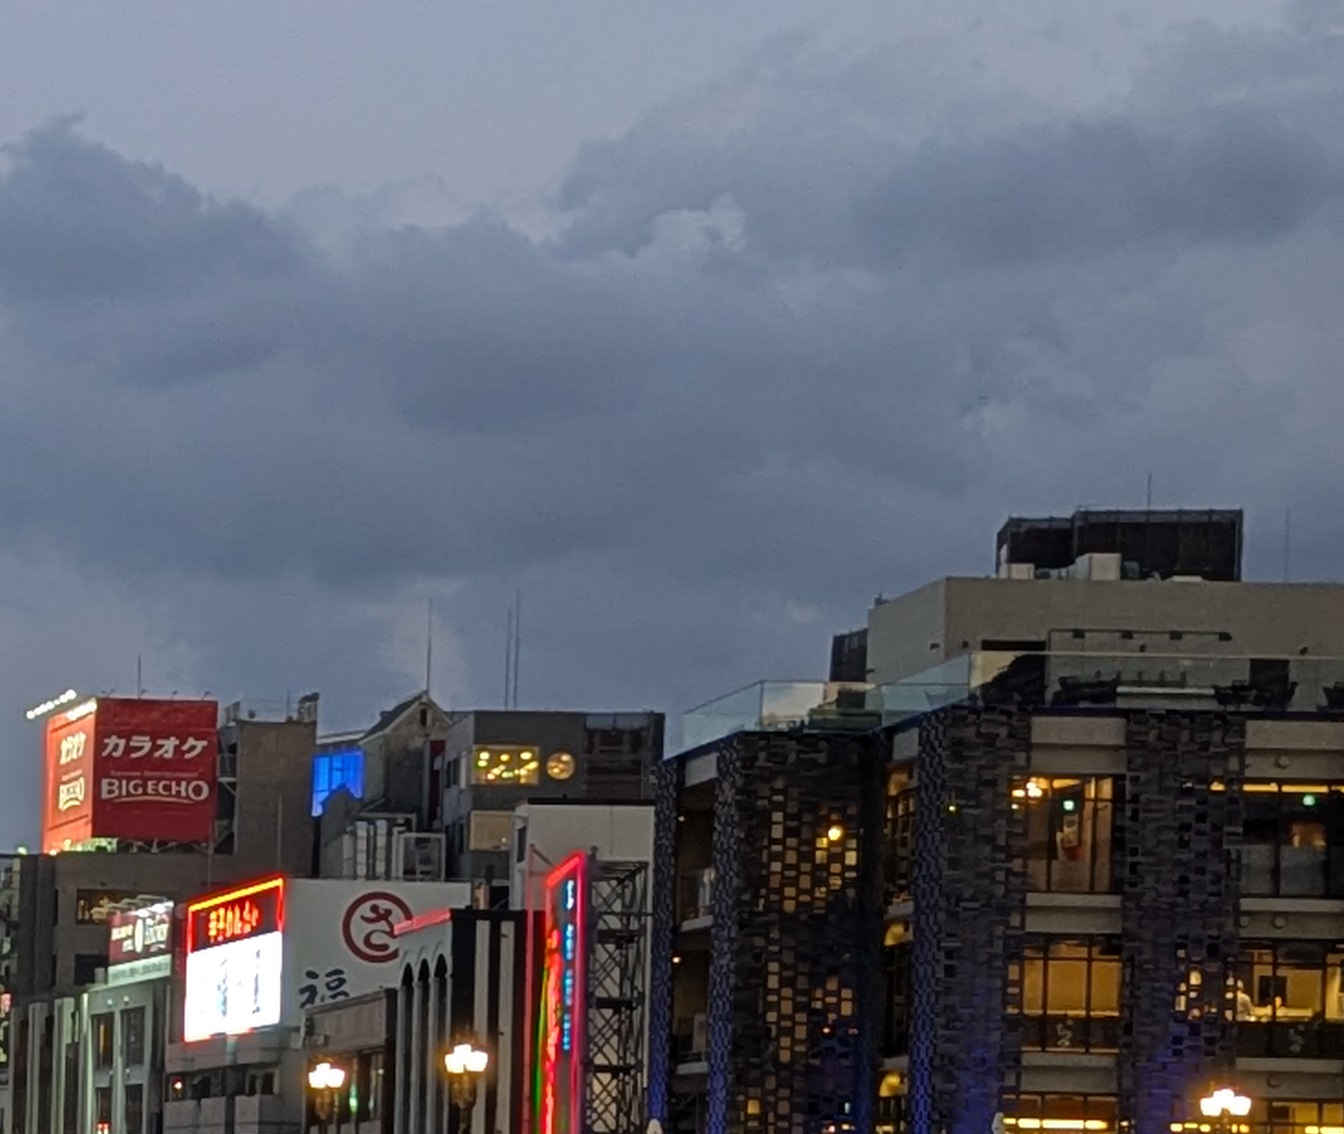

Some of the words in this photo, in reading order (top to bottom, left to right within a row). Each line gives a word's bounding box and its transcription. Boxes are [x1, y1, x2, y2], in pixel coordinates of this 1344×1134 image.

[101, 734, 208, 760] カラオケ
[100, 778, 143, 800] BIG
[147, 780, 210, 801] ECHO
